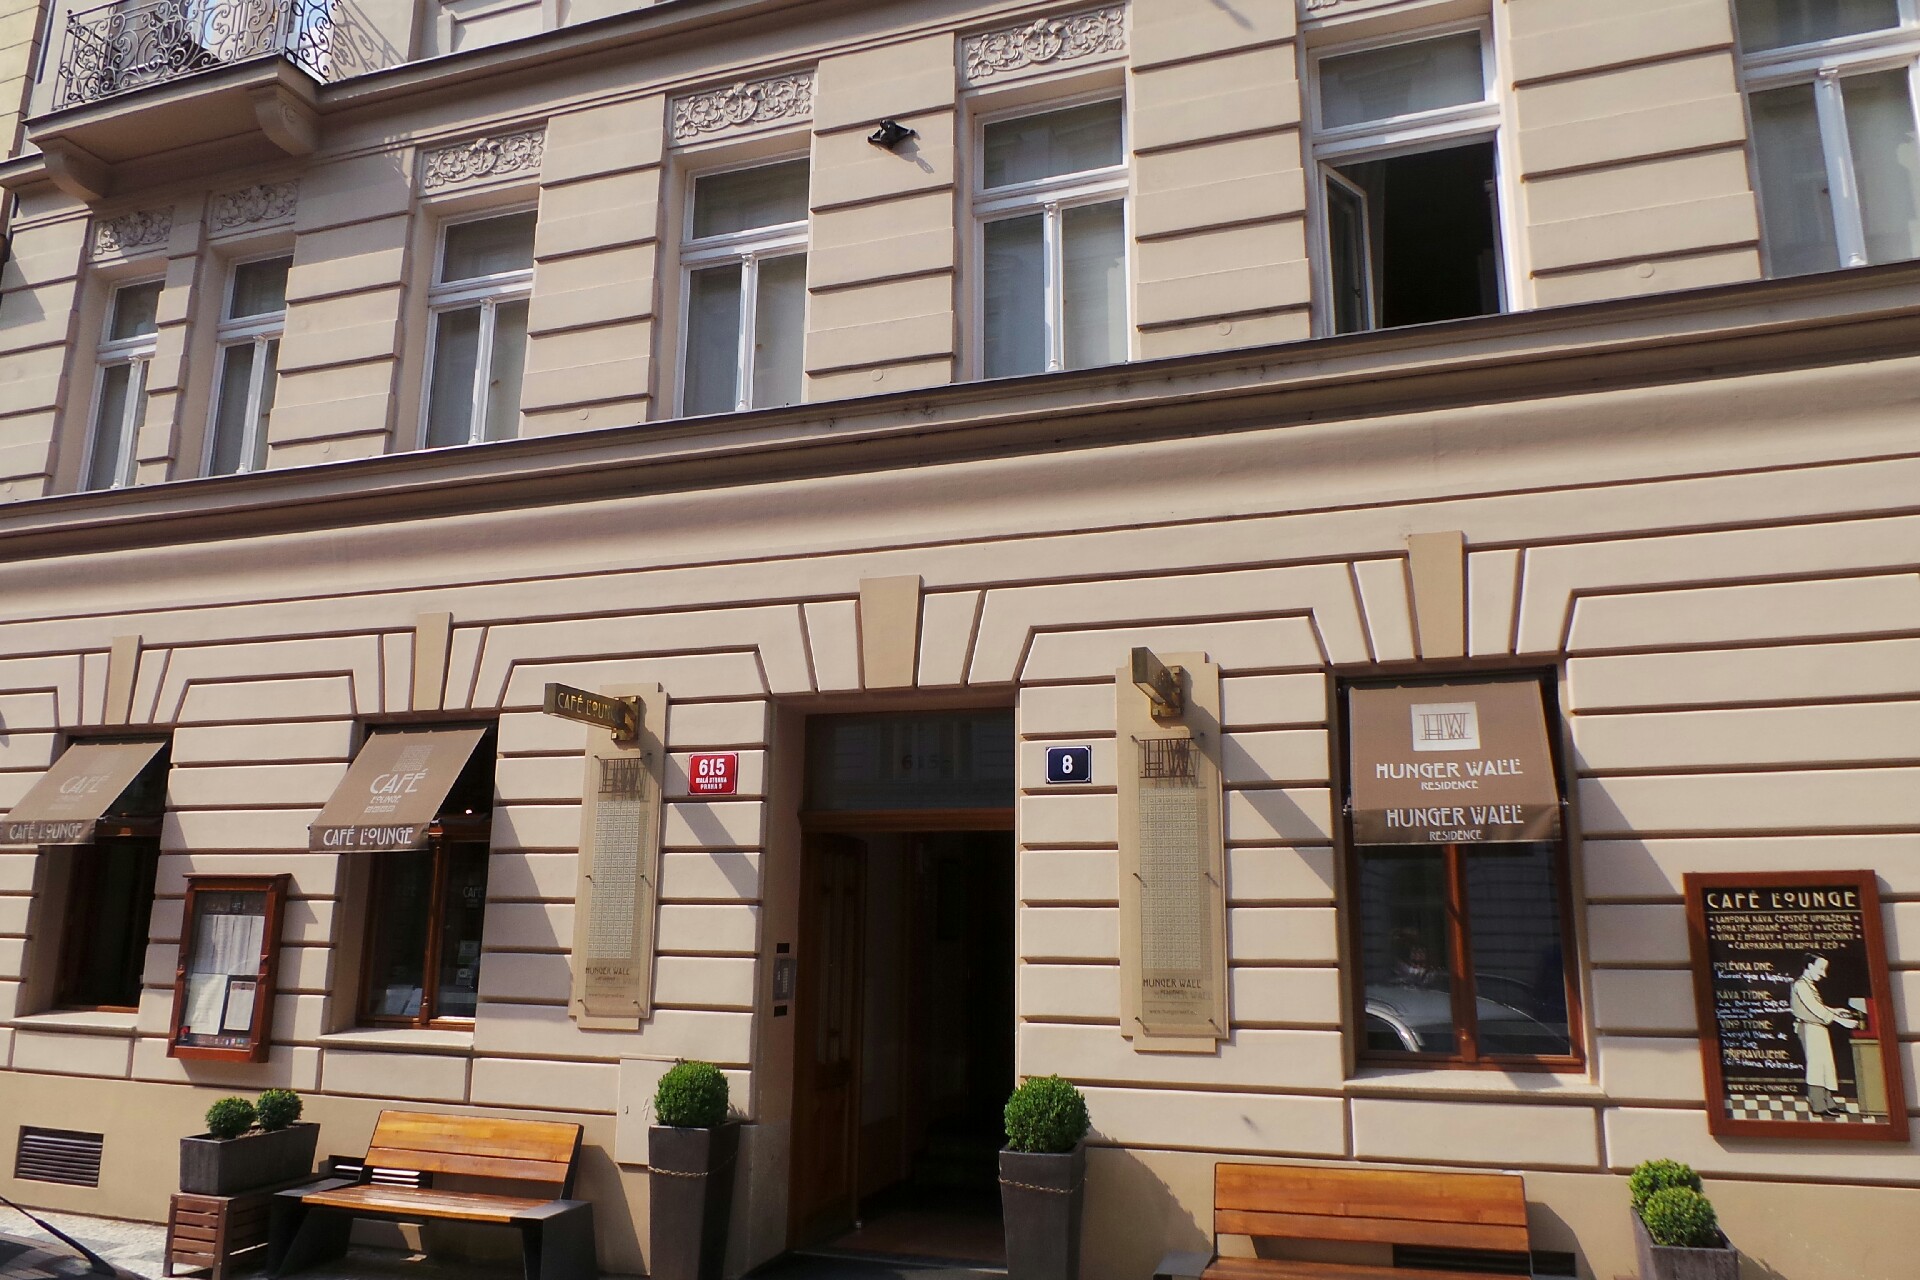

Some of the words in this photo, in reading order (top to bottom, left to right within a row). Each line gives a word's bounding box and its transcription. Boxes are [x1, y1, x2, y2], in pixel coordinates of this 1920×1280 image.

[557, 692, 583, 713] CAFÉ
[586, 700, 615, 721] LOUN
[699, 758, 725, 776] 615
[1062, 754, 1073, 774] 8
[1376, 762, 1461, 779] HUNGER
[1465, 759, 1523, 776] WALL
[370, 768, 429, 794] CAFÉ
[1421, 780, 1478, 791] RESIDENCE
[1386, 807, 1466, 828] HUNGER
[1470, 805, 1524, 825] WALL
[9, 821, 35, 840] CAFÉ
[38, 822, 82, 840] LOUNGE
[323, 825, 355, 846] CAFÉ
[360, 827, 413, 846] LOUNGE
[1429, 829, 1482, 841] RESIDENCE
[1707, 890, 1760, 909] CAFÉ
[1771, 891, 1856, 908] LOUNGE
[1752, 913, 1773, 923] KÁVA
[1713, 960, 1752, 971] POLÉVKA
[1143, 978, 1177, 988] HUNGER
[1179, 978, 1202, 988] WALL
[1716, 989, 1740, 1000] KÁVA
